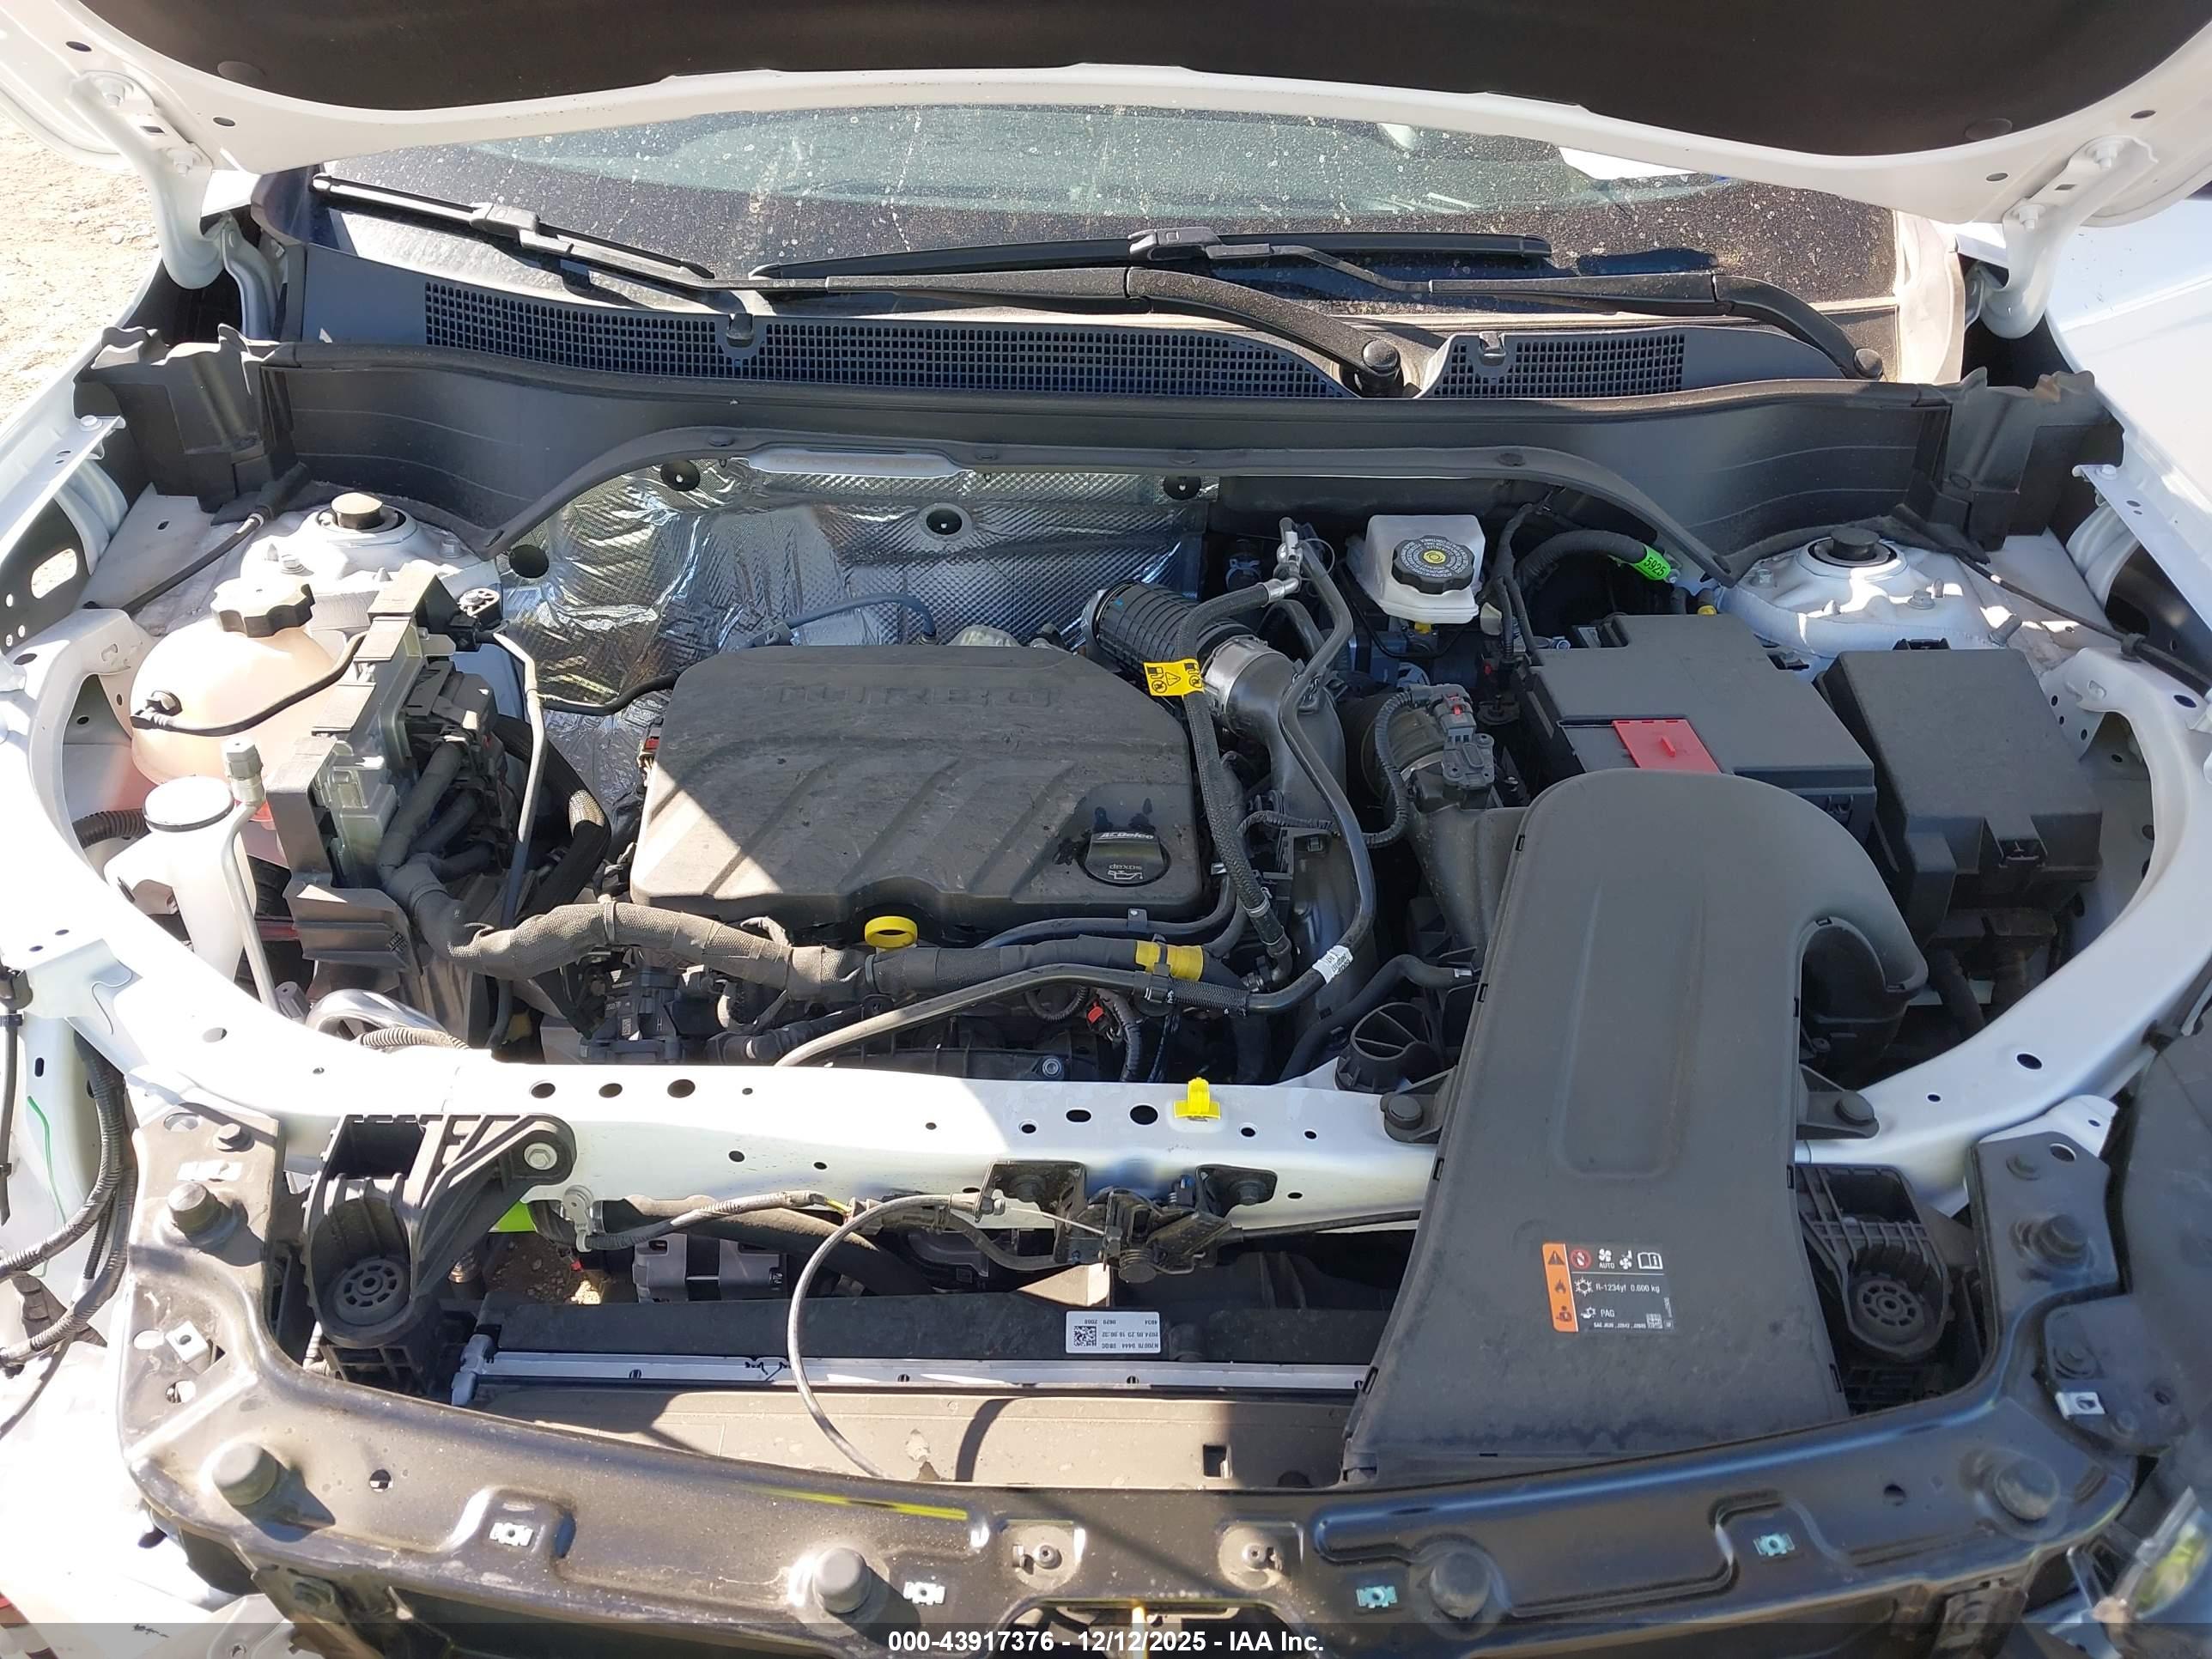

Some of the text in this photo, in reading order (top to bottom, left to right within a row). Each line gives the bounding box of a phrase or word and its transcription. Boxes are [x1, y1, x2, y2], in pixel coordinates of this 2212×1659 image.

[1644, 556, 1667, 576] 5925
[1098, 831, 1154, 840] ACDelco
[1595, 1284, 1626, 1293] R-1234yf
[1650, 1284, 1660, 1294] kg
[1600, 1309, 1615, 1317] PAG
